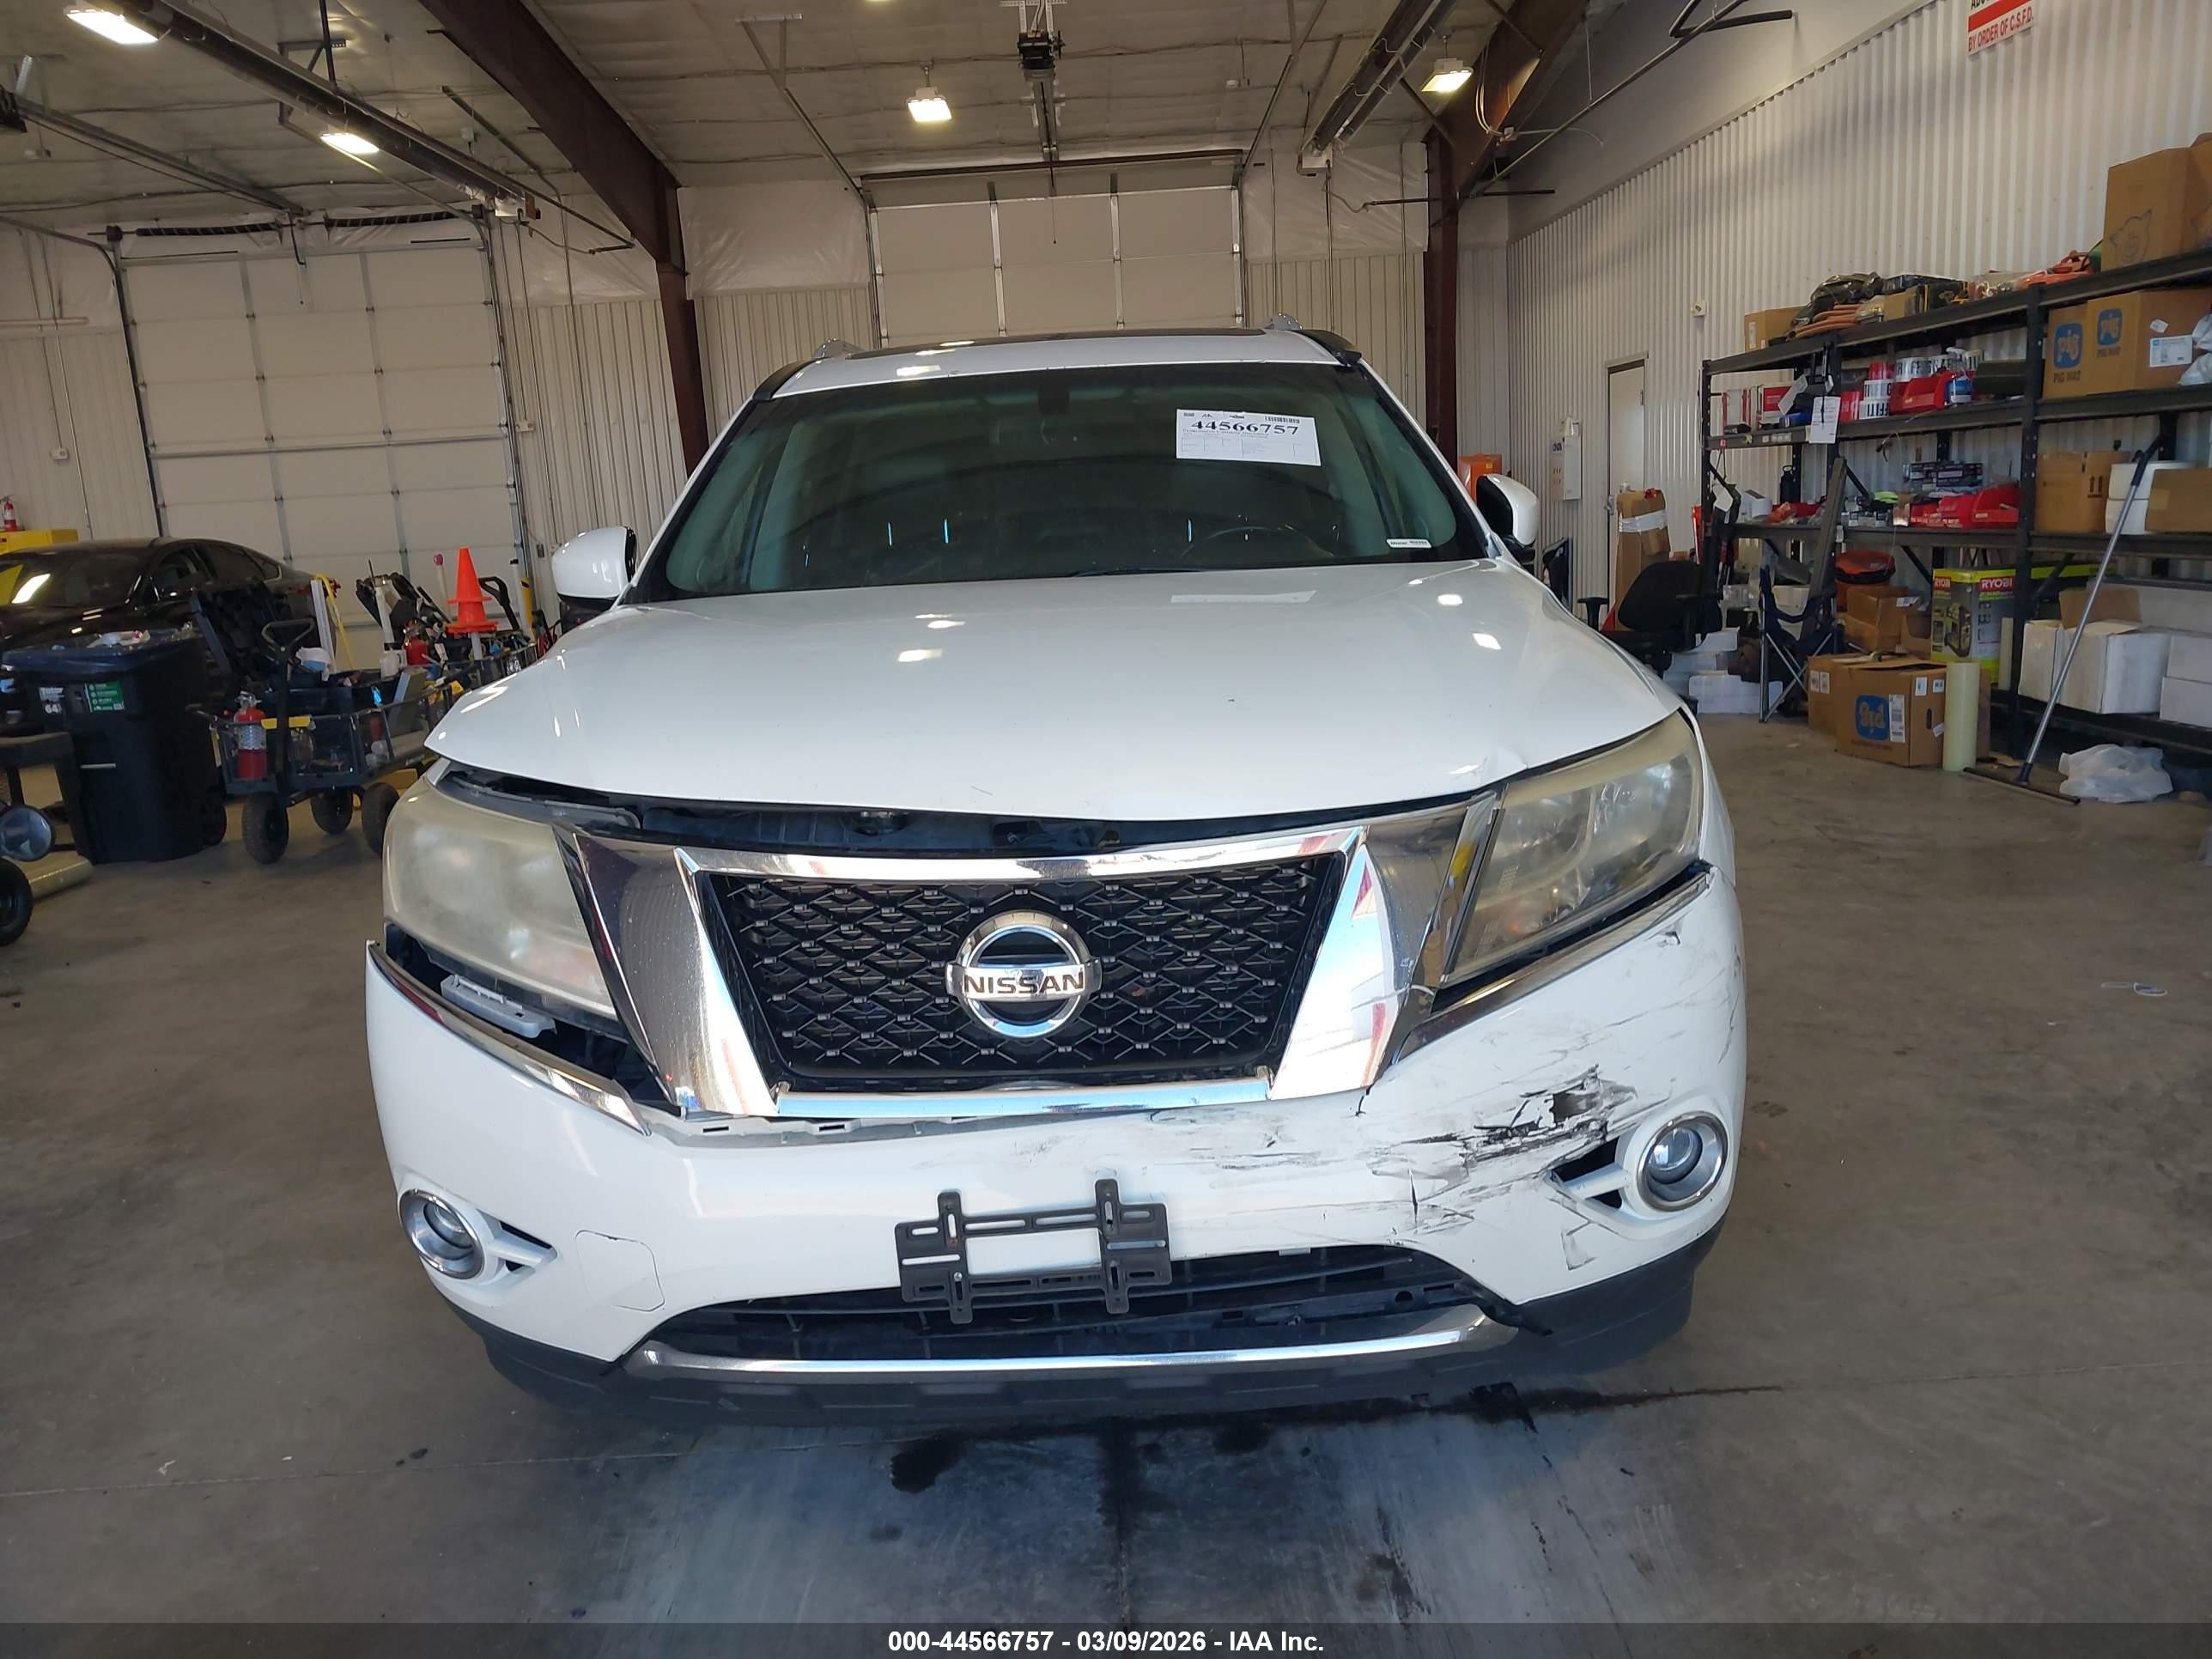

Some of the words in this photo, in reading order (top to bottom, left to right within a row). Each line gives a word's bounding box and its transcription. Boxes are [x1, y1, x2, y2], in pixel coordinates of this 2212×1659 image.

[1968, 35, 1977, 52] BY
[1978, 24, 1998, 46] ORDER
[2000, 18, 2008, 35] OF
[1191, 420, 1299, 435] 44566757
[1981, 578, 2013, 589] RYOBI
[963, 972, 1084, 994] NISSAN
